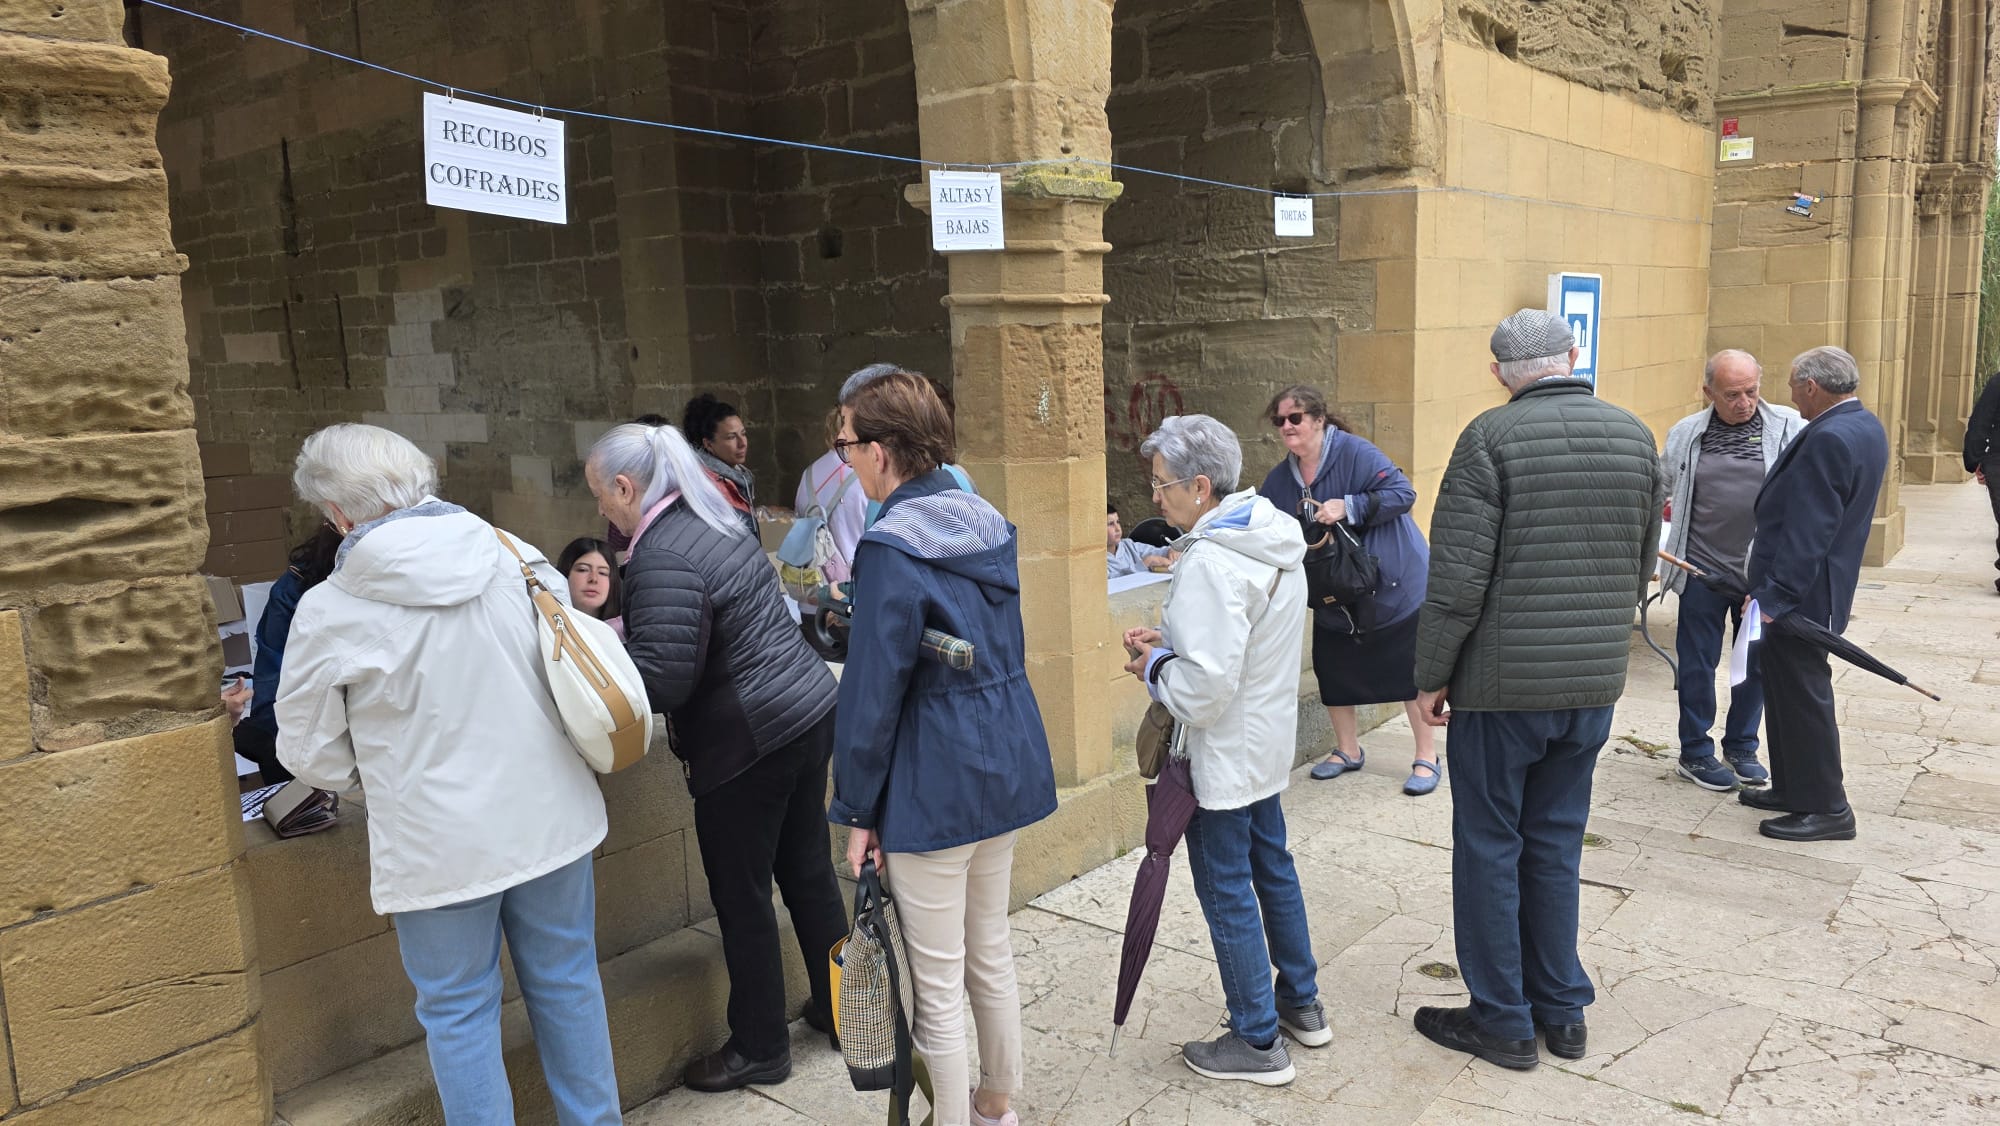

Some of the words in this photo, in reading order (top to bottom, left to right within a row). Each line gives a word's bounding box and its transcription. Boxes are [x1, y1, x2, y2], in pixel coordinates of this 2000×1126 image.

[443, 120, 547, 158] RECIBOS
[430, 162, 560, 201] COFRADES
[939, 187, 982, 203] ALTAS
[984, 185, 994, 203] Y
[1280, 209, 1307, 221] TORTAS
[946, 219, 990, 235] BAJAS
